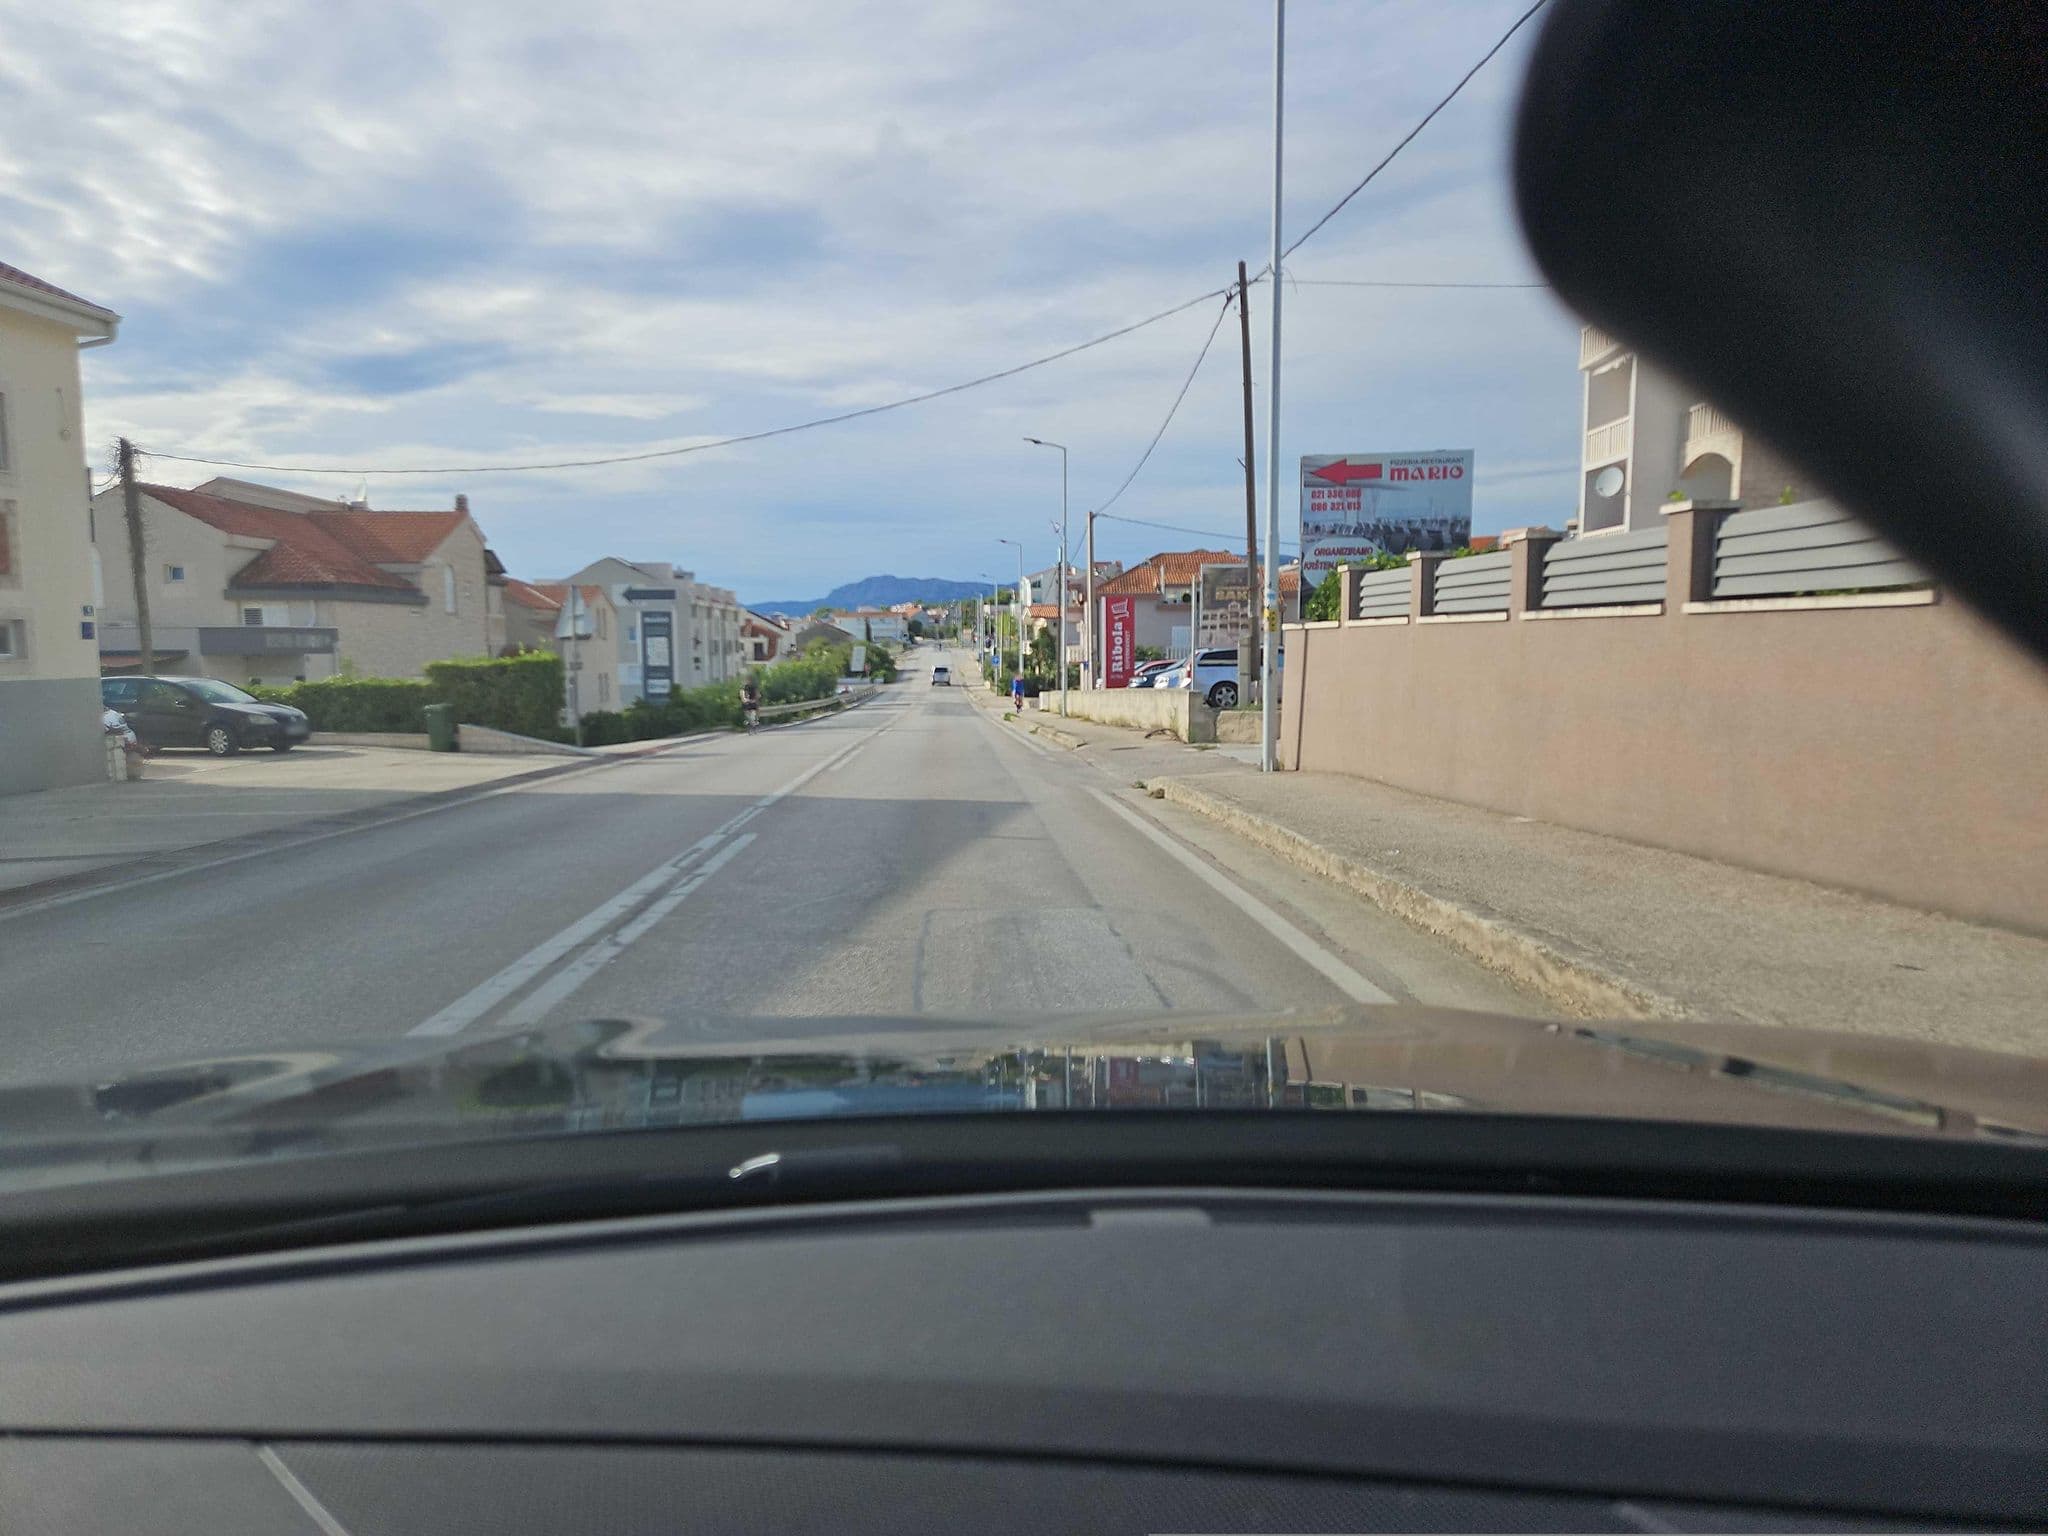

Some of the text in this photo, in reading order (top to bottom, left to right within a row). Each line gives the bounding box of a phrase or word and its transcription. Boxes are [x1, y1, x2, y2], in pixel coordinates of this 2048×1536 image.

[1390, 464, 1464, 480] MARIO
[1314, 546, 1374, 557] ORGANIZIRAMO
[1112, 621, 1123, 672] Ribola
